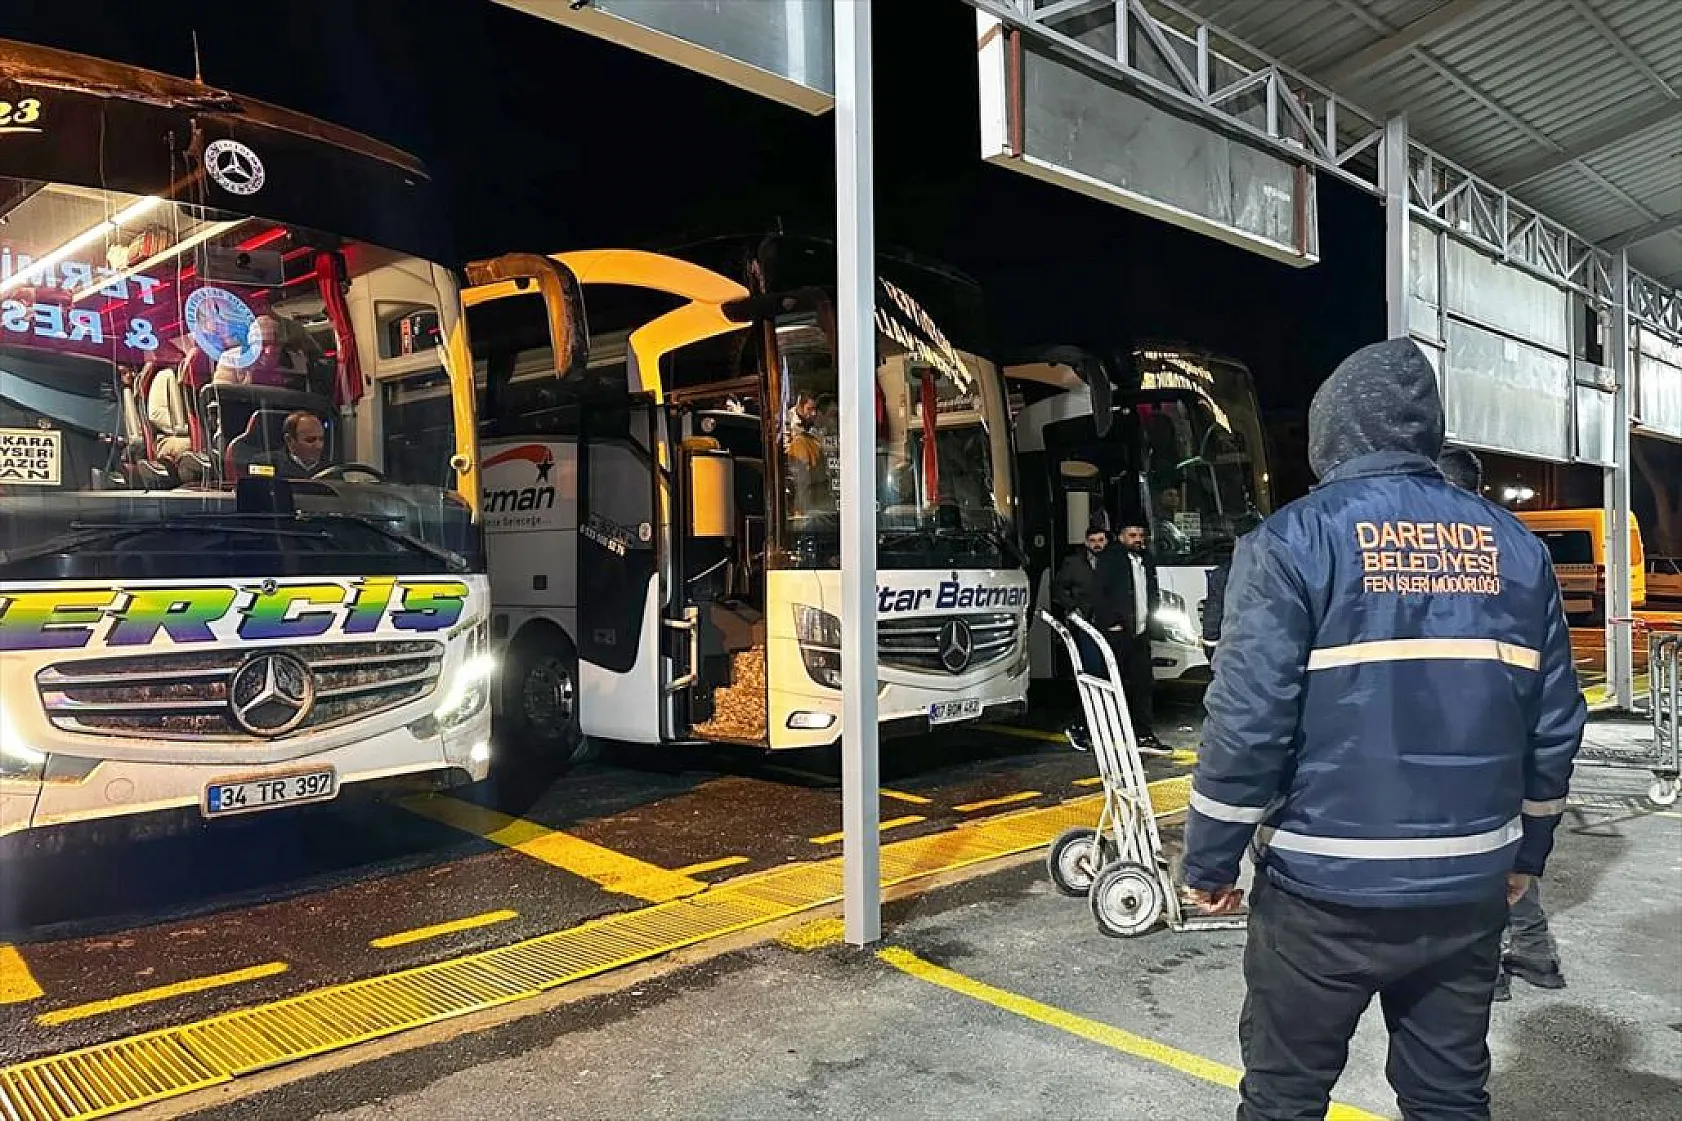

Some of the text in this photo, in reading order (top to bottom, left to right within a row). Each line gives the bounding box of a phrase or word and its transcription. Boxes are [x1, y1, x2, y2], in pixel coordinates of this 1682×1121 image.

[0, 436, 54, 446] KARA
[0, 469, 49, 479] AN
[1356, 520, 1498, 551] DARENDE
[1362, 549, 1498, 575] BELEDİYESİ
[876, 581, 1028, 613] tar Batman
[1364, 575, 1395, 593] FEN
[222, 774, 330, 806] 34 TR 397
